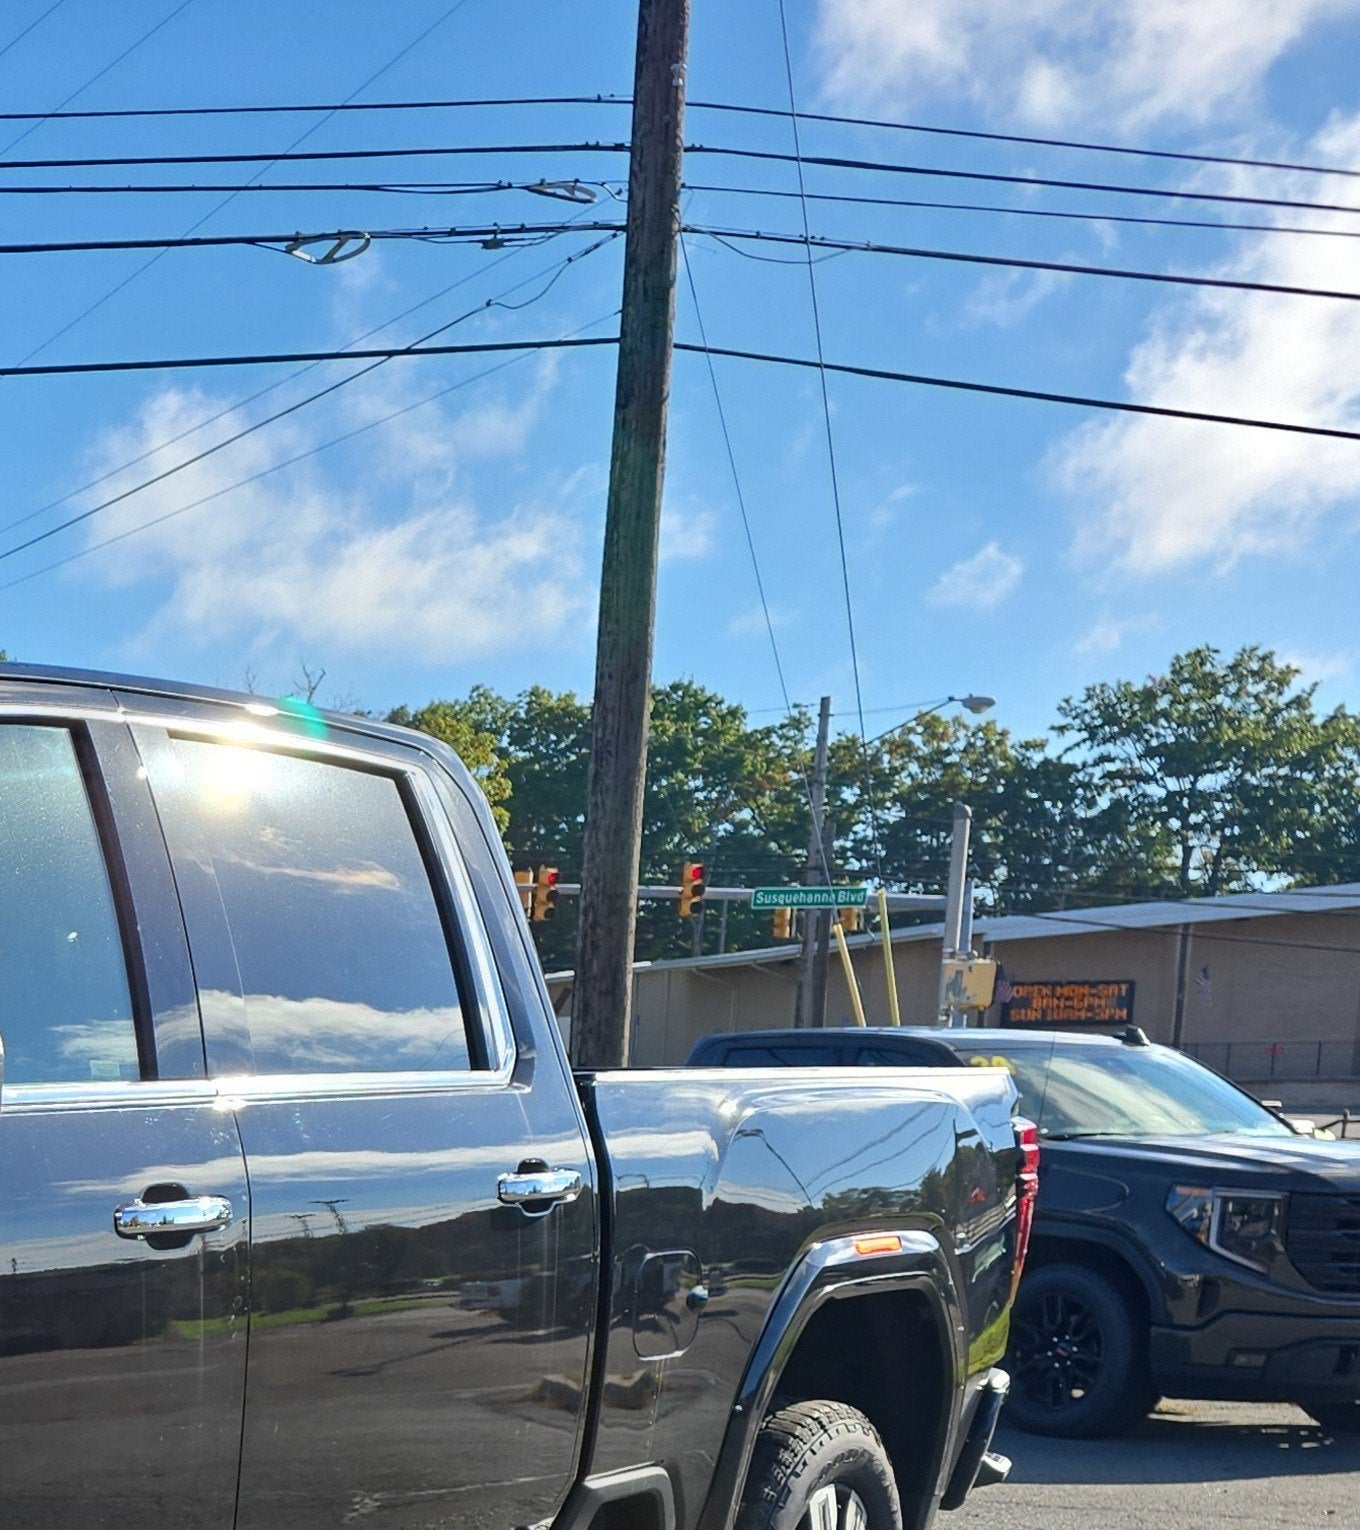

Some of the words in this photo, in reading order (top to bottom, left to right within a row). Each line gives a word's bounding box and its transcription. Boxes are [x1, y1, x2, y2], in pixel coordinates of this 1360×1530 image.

[755, 890, 836, 906] Susquehanna
[837, 889, 865, 904] Blvd
[1012, 984, 1053, 998] OPEN
[1054, 983, 1130, 998] MON-SAT
[1009, 1008, 1042, 1021] SUN
